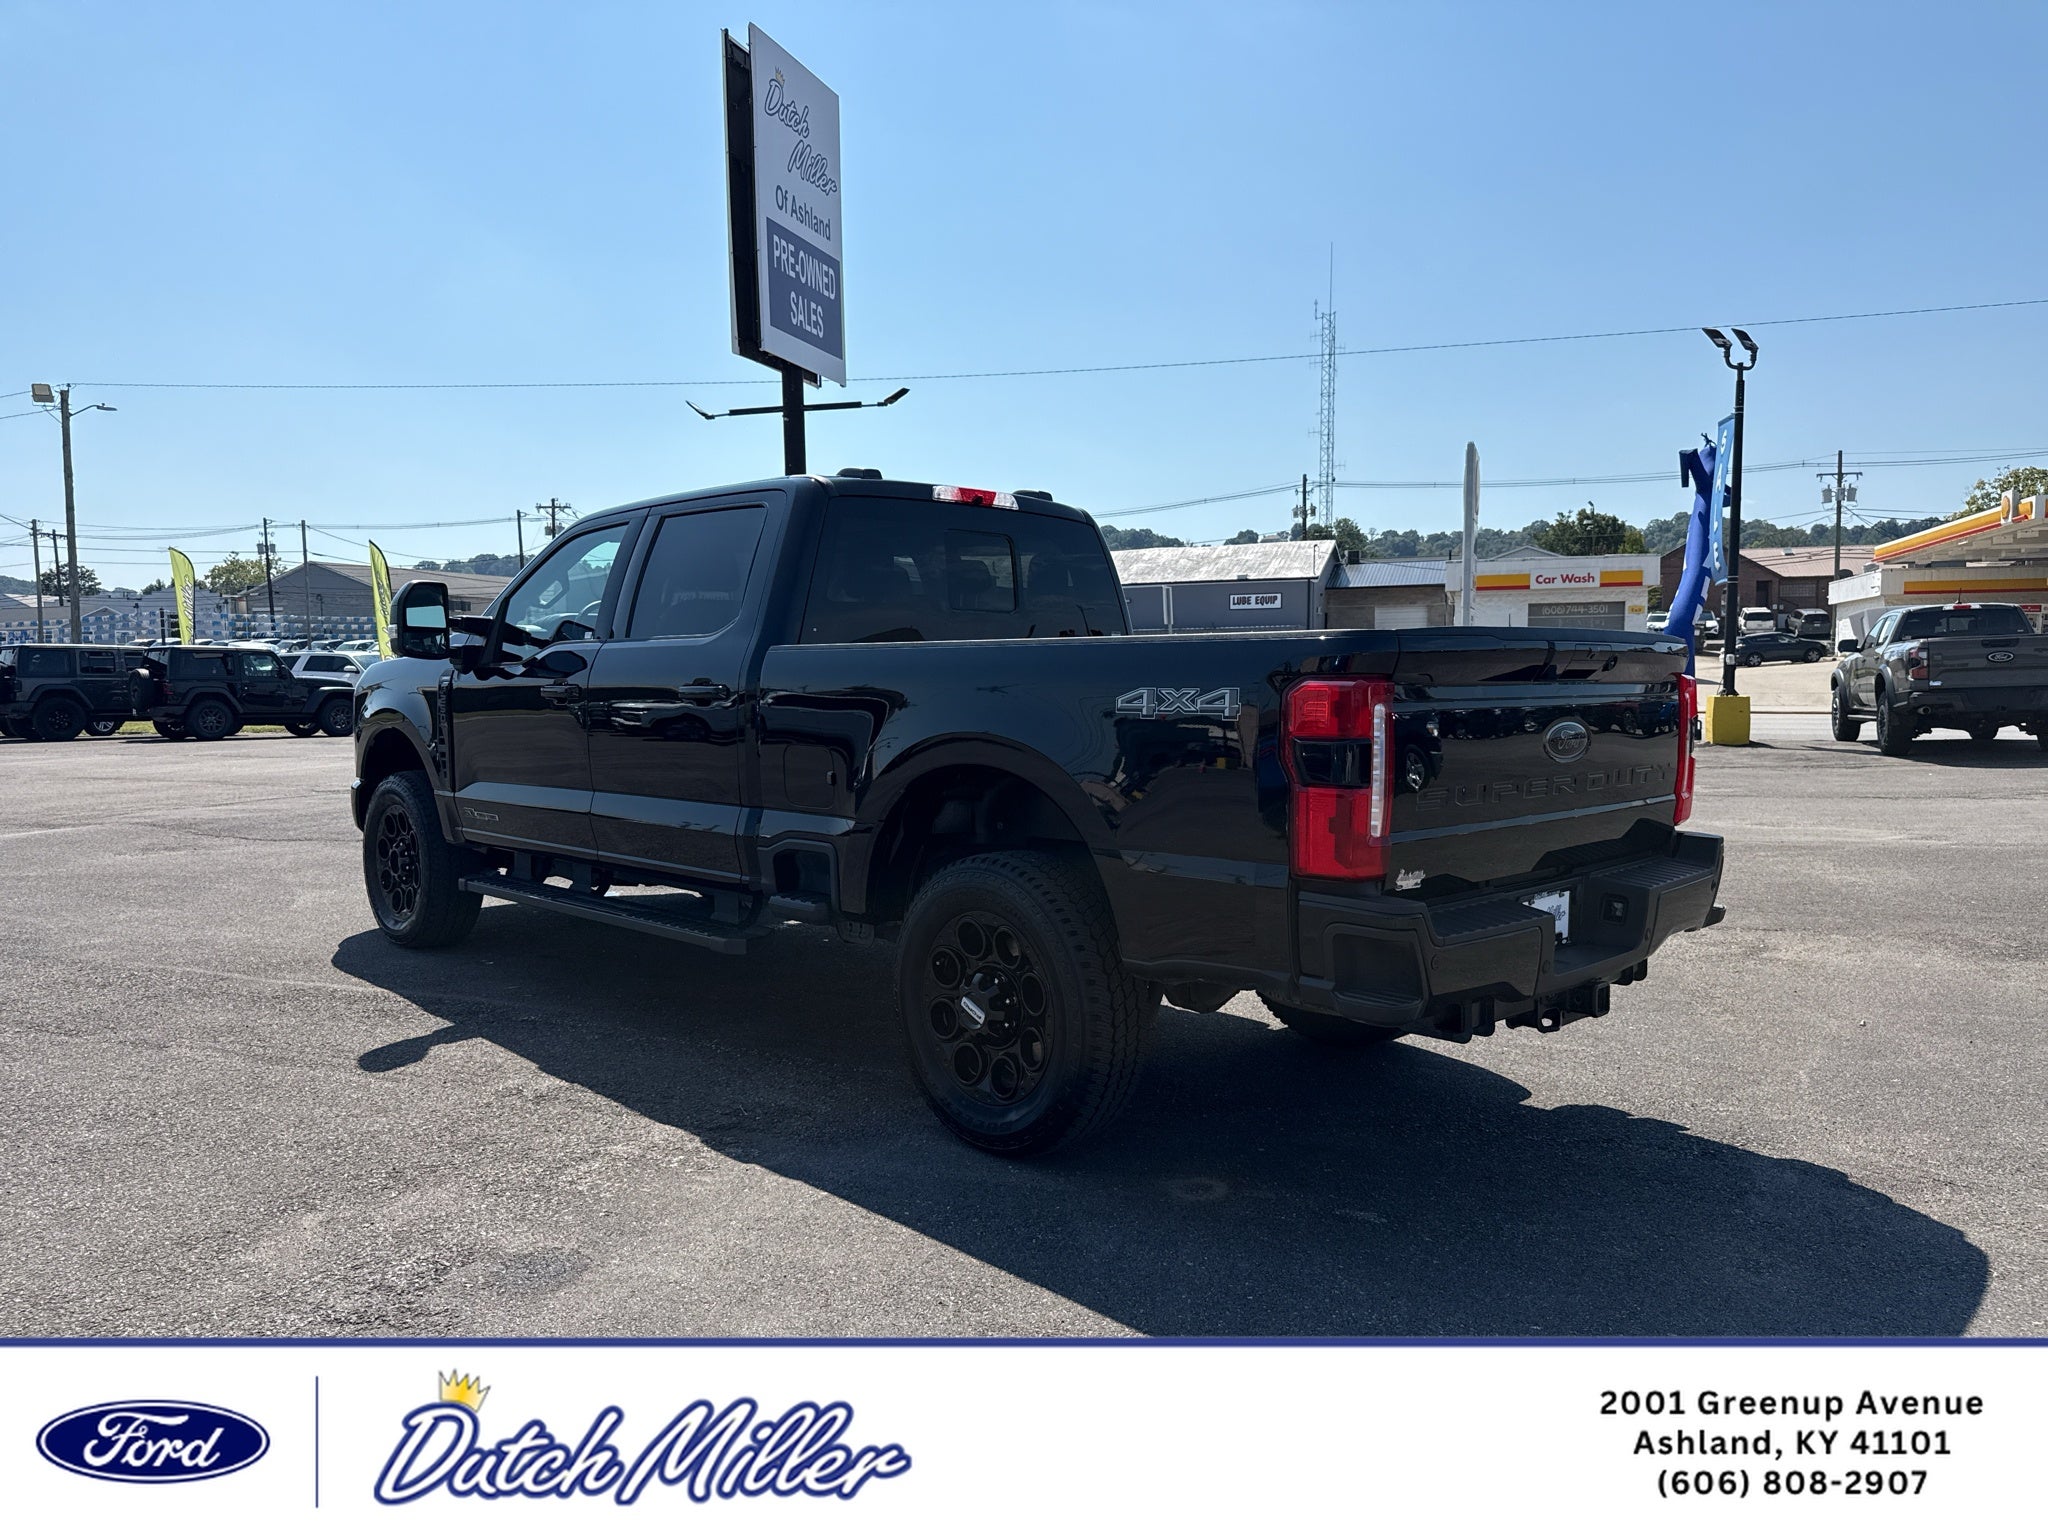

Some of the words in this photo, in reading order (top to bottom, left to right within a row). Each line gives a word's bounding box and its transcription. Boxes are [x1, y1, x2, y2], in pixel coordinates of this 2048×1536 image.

[764, 79, 810, 138] Dutch
[788, 139, 837, 196] Miller
[775, 184, 789, 212] Of
[790, 196, 832, 241] Ashland
[773, 235, 835, 300] PRE-OWNED
[789, 294, 825, 339] SALES
[1232, 595, 1253, 606] LUBE
[1254, 594, 1279, 606] EQUIP
[1535, 574, 1557, 585] Car
[1560, 572, 1595, 584] Wash
[1415, 774, 1577, 812] SUPER
[1586, 762, 1670, 792] DUTY
